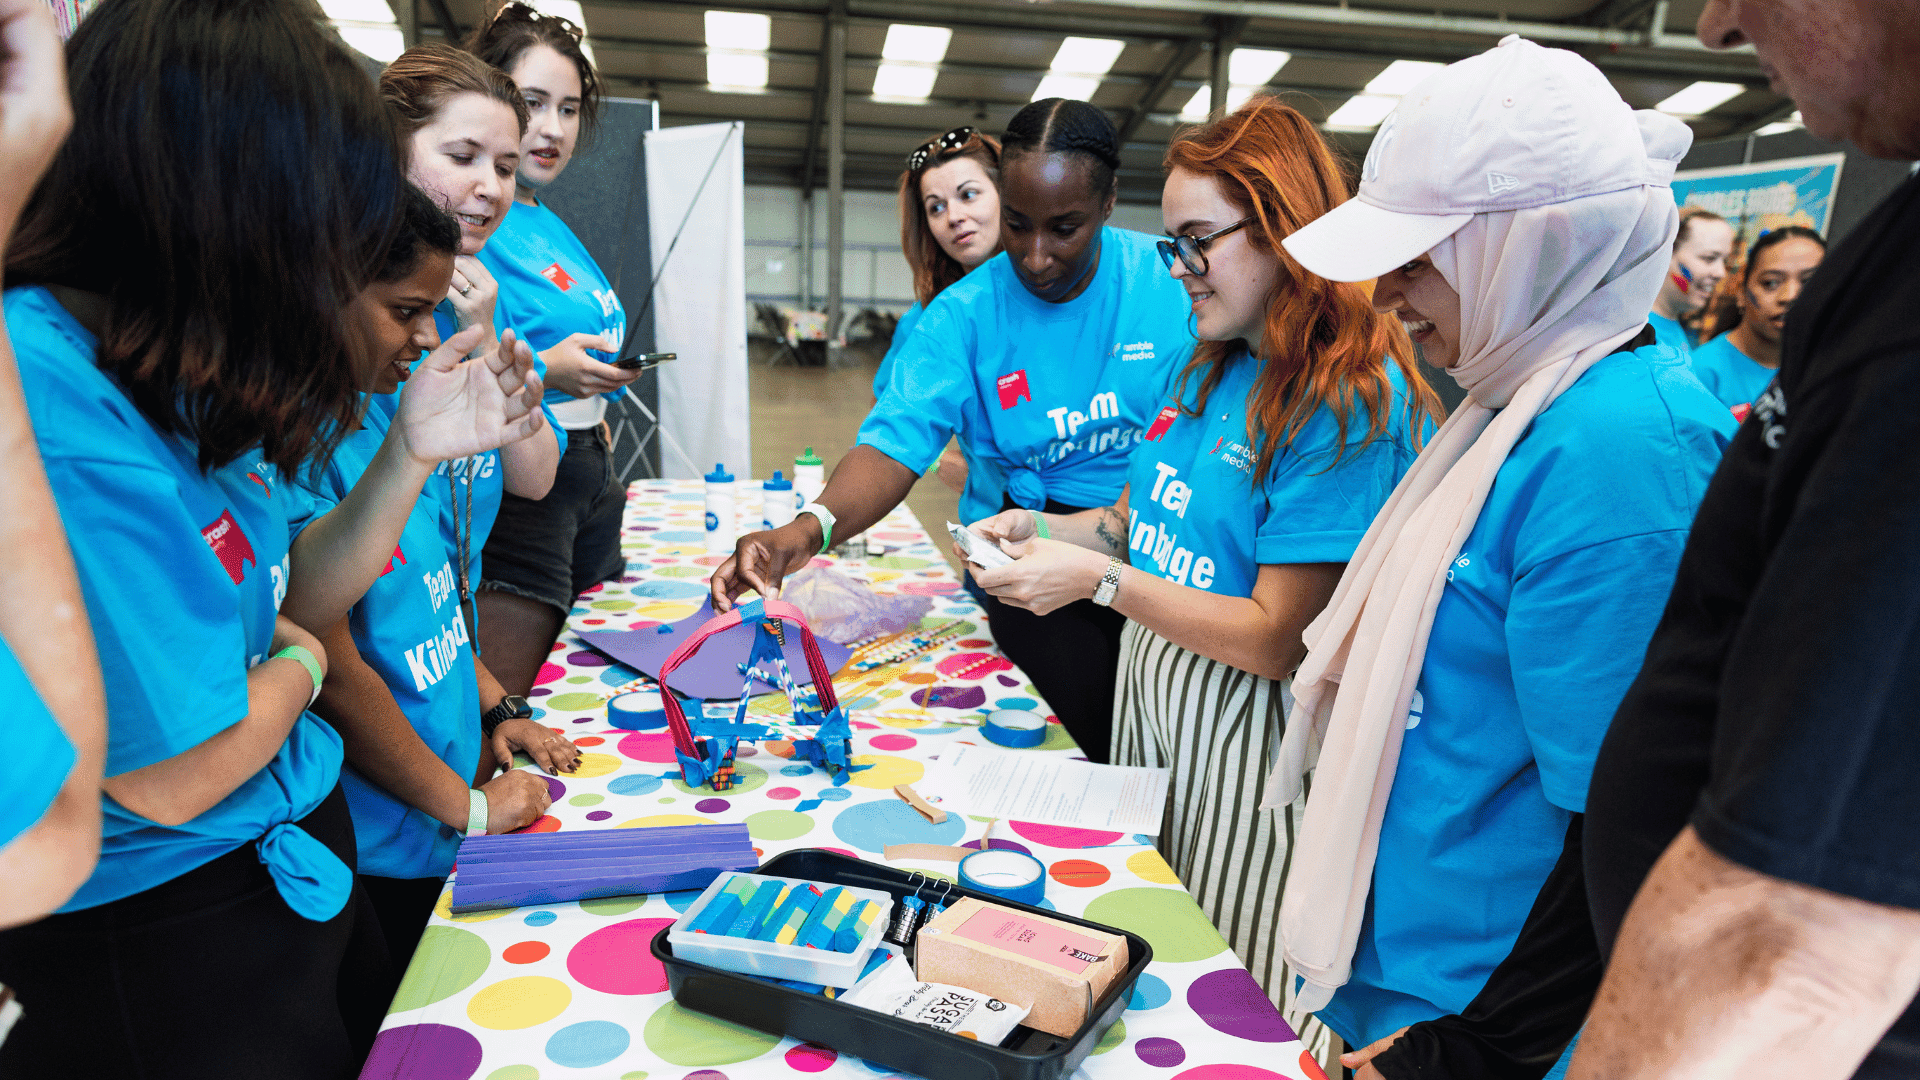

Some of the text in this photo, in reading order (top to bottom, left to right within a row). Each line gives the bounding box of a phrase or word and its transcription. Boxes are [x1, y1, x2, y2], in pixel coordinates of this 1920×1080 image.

[1047, 391, 1119, 439] Tem
[1074, 950, 1099, 962] BAKE
[922, 992, 961, 1026] PAST
